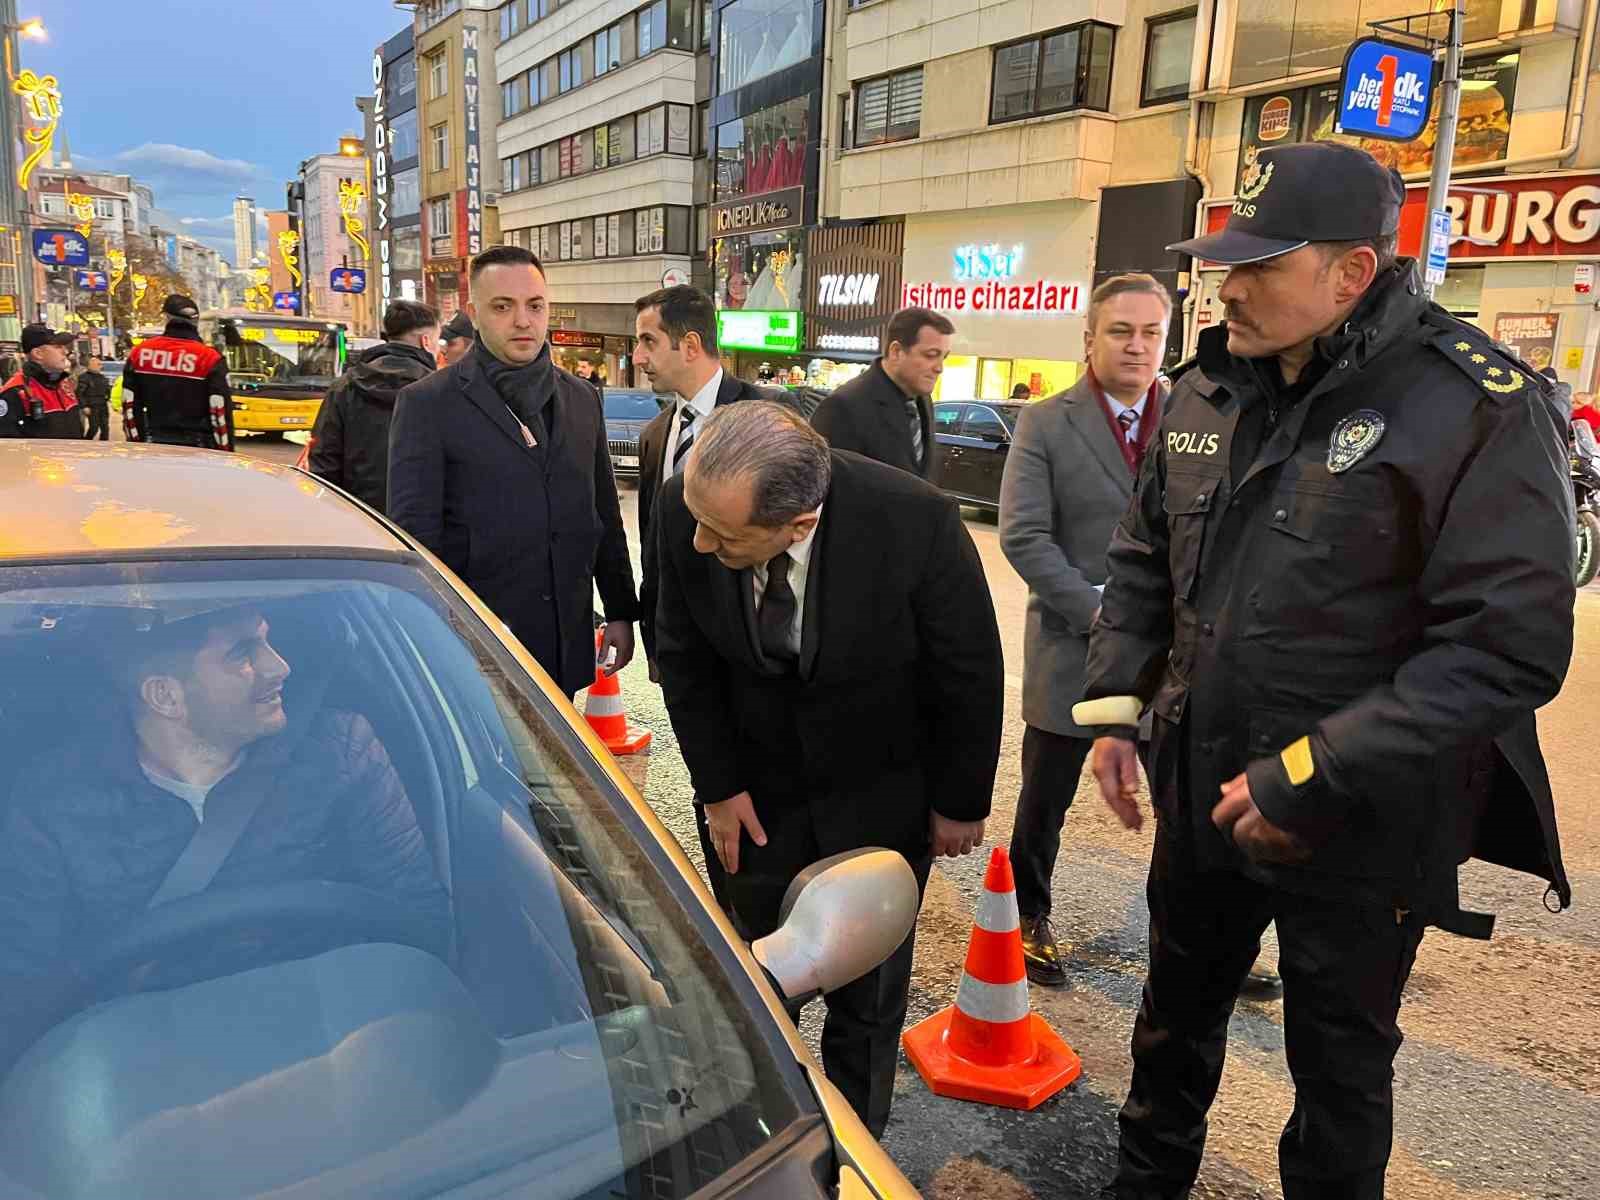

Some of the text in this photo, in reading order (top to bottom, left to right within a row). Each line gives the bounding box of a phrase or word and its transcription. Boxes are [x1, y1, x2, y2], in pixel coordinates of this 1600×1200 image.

[1347, 90, 1381, 111] yere
[1358, 73, 1382, 95] her
[1376, 54, 1398, 127] 1
[467, 145, 480, 254] AJANS
[818, 273, 880, 305] TILSIM
[139, 347, 198, 373] POLİS
[1167, 431, 1220, 455] POLİS
